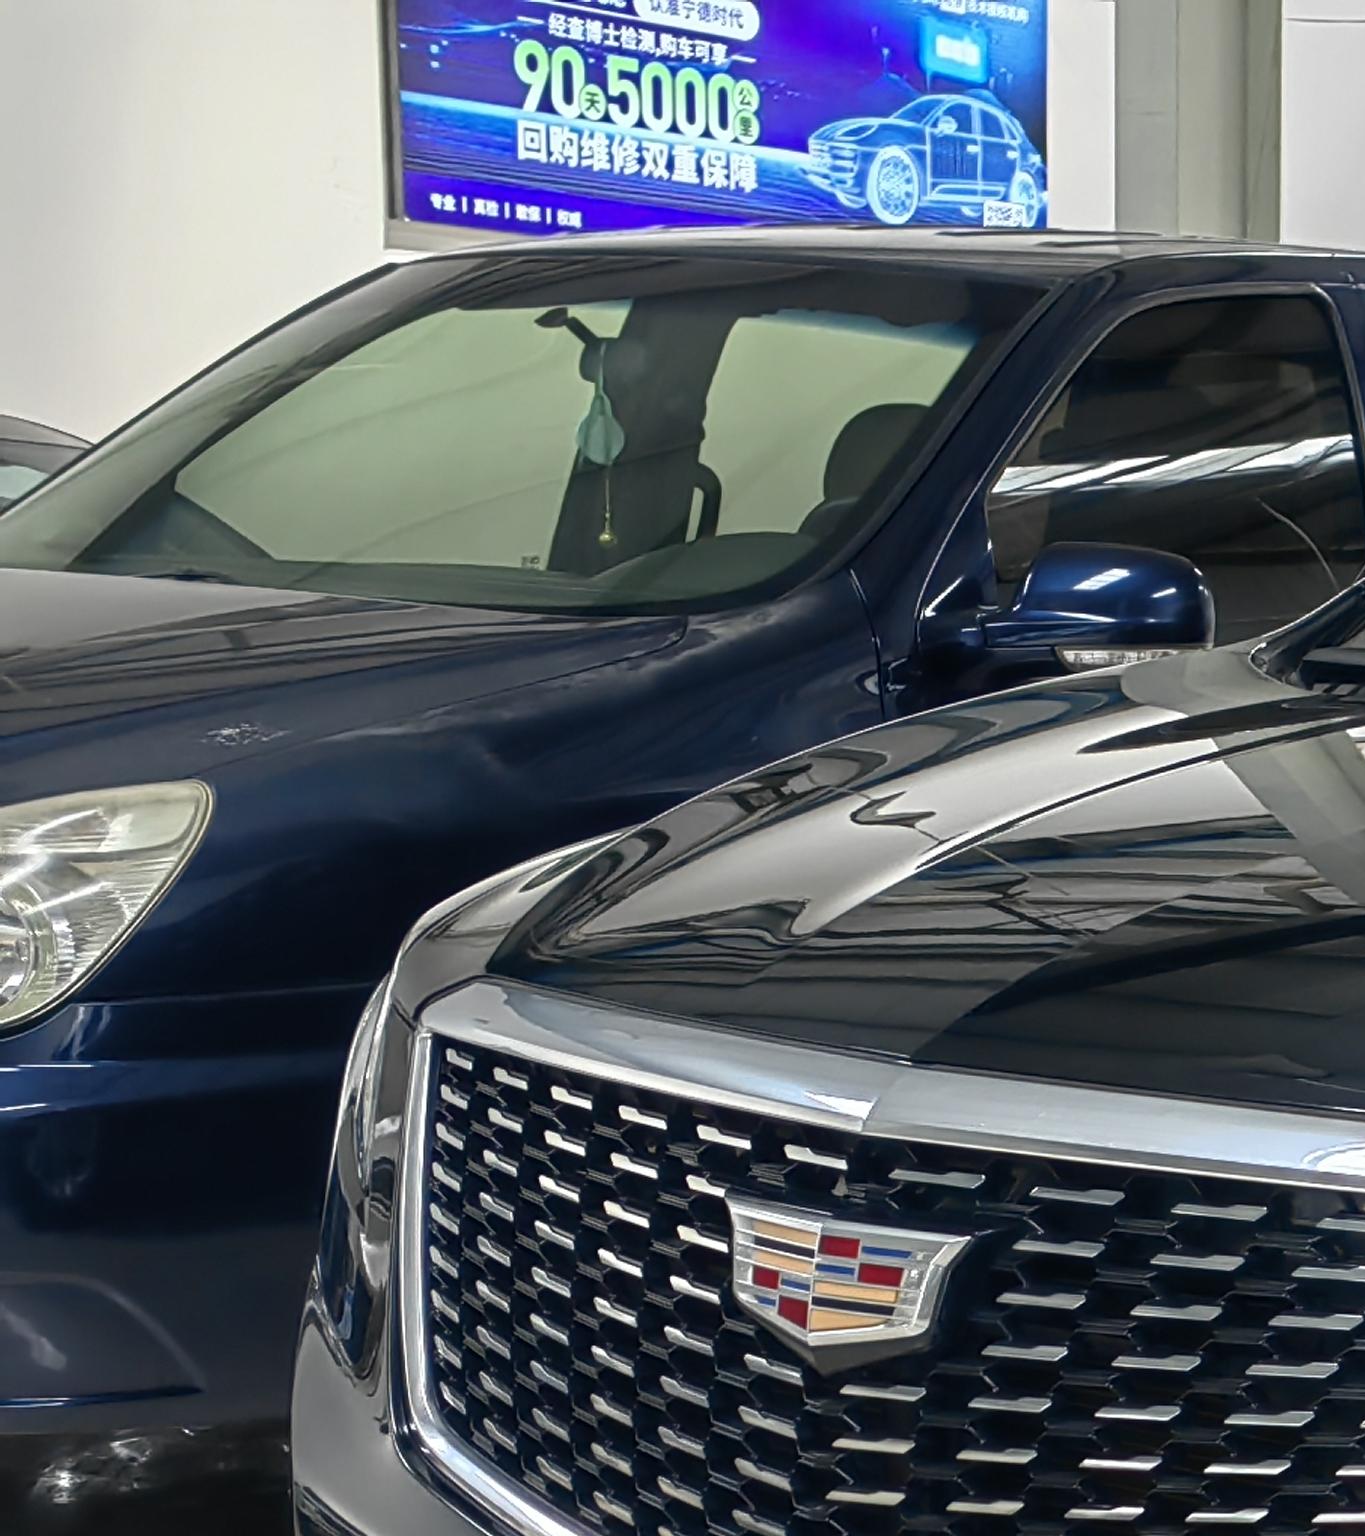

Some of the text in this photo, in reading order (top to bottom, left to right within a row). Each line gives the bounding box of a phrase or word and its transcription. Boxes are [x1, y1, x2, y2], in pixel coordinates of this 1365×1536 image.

[517, 120, 759, 193] 回购维修双重保障
